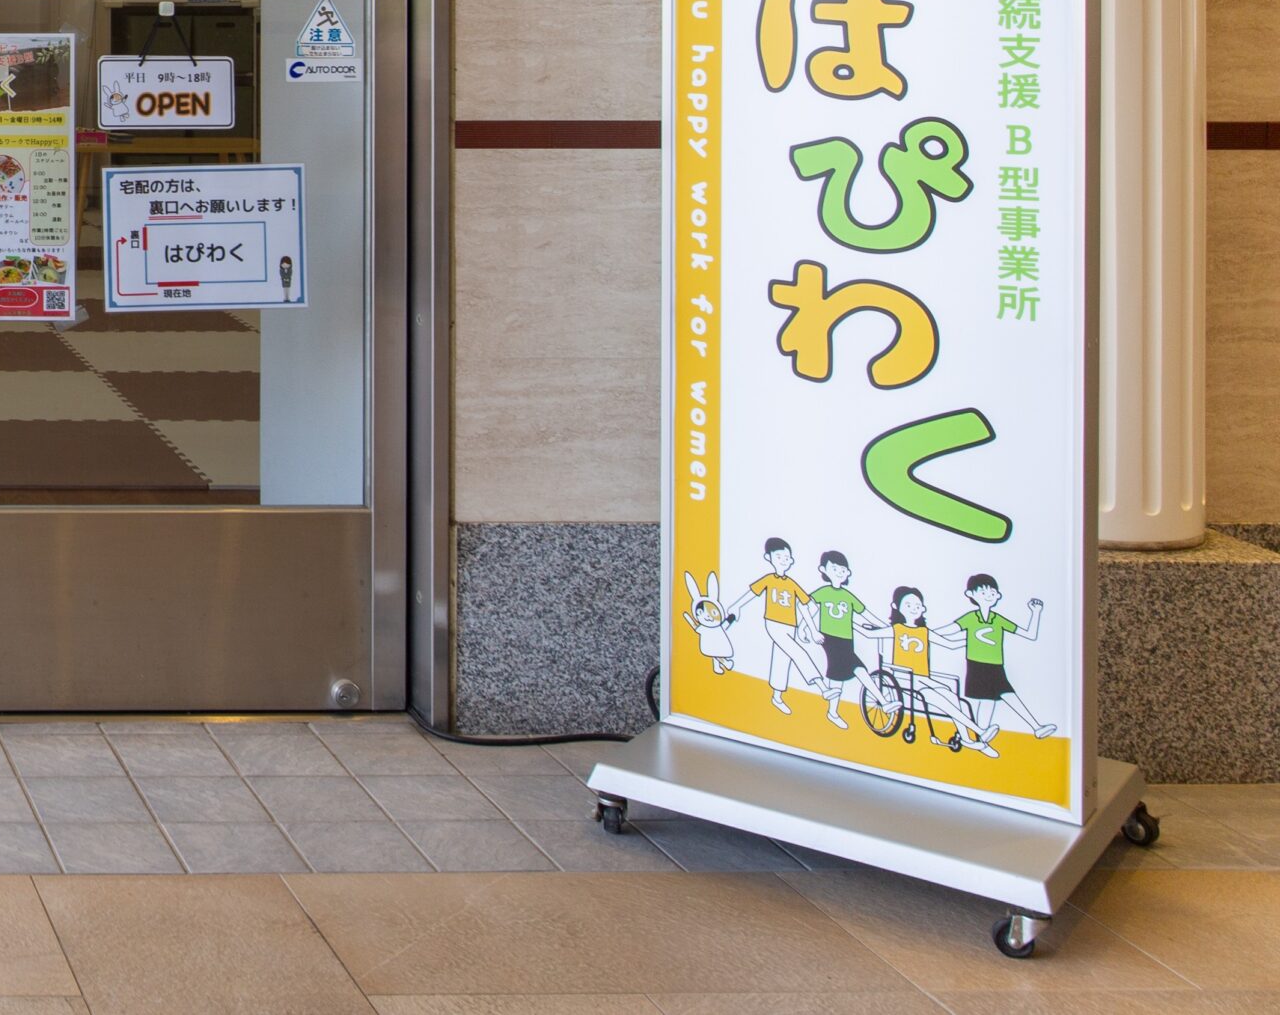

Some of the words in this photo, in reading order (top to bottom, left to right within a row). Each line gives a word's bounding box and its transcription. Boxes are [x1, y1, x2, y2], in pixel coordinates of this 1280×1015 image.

[310, 28, 341, 42] 注意
[124, 72, 146, 83] 平日
[136, 91, 211, 117] OPEN
[687, 45, 714, 158] happy
[119, 180, 204, 195] 宅配の方は、
[149, 198, 297, 215] 裏口へお願いします！
[691, 182, 713, 270] work
[130, 230, 140, 249] 裏口
[164, 244, 244, 263] はぴわく
[163, 289, 192, 299] 現在地
[691, 294, 713, 357] for
[690, 381, 707, 500] women
[771, 587, 791, 608] は
[898, 634, 924, 653] わ
